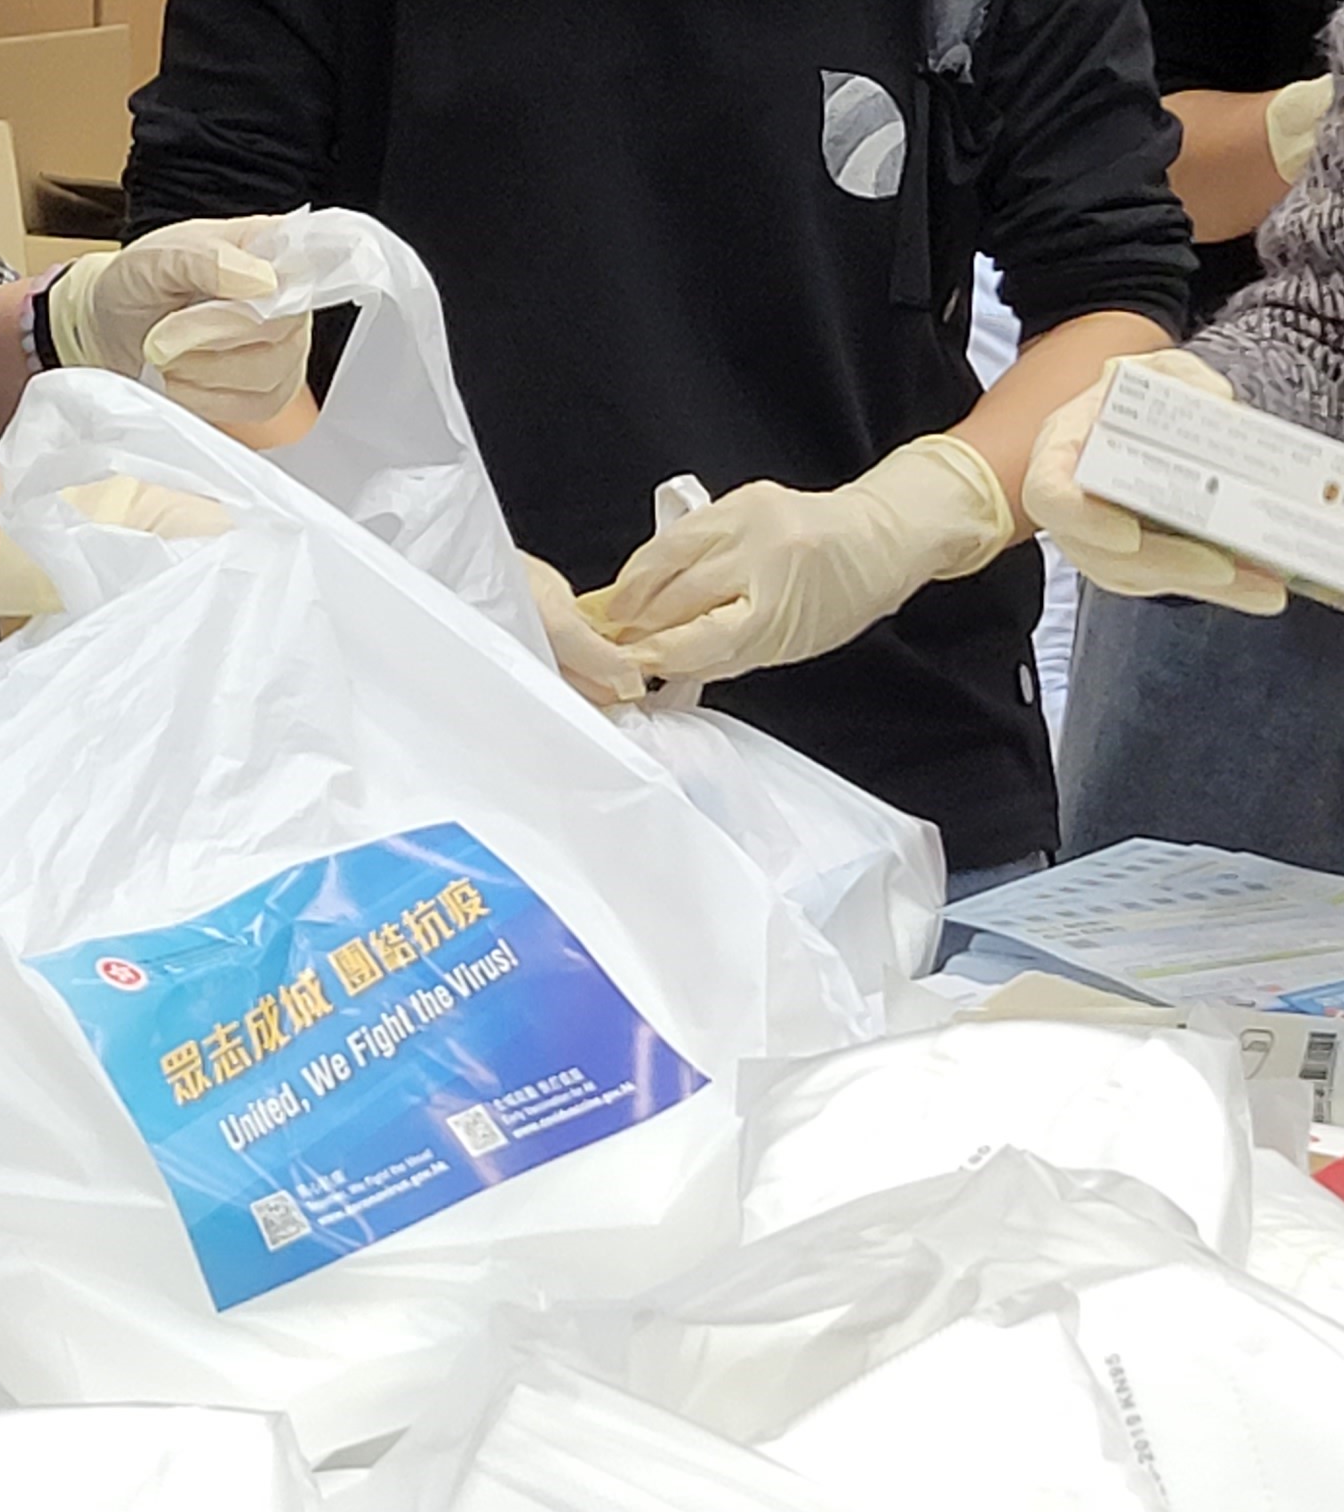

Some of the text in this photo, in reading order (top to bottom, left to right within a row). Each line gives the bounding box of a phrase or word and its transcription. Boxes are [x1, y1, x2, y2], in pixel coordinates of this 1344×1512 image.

[159, 877, 492, 1107] 眾志成城 團結抗疫
[219, 937, 521, 1152] United, We Fight the Virus!
